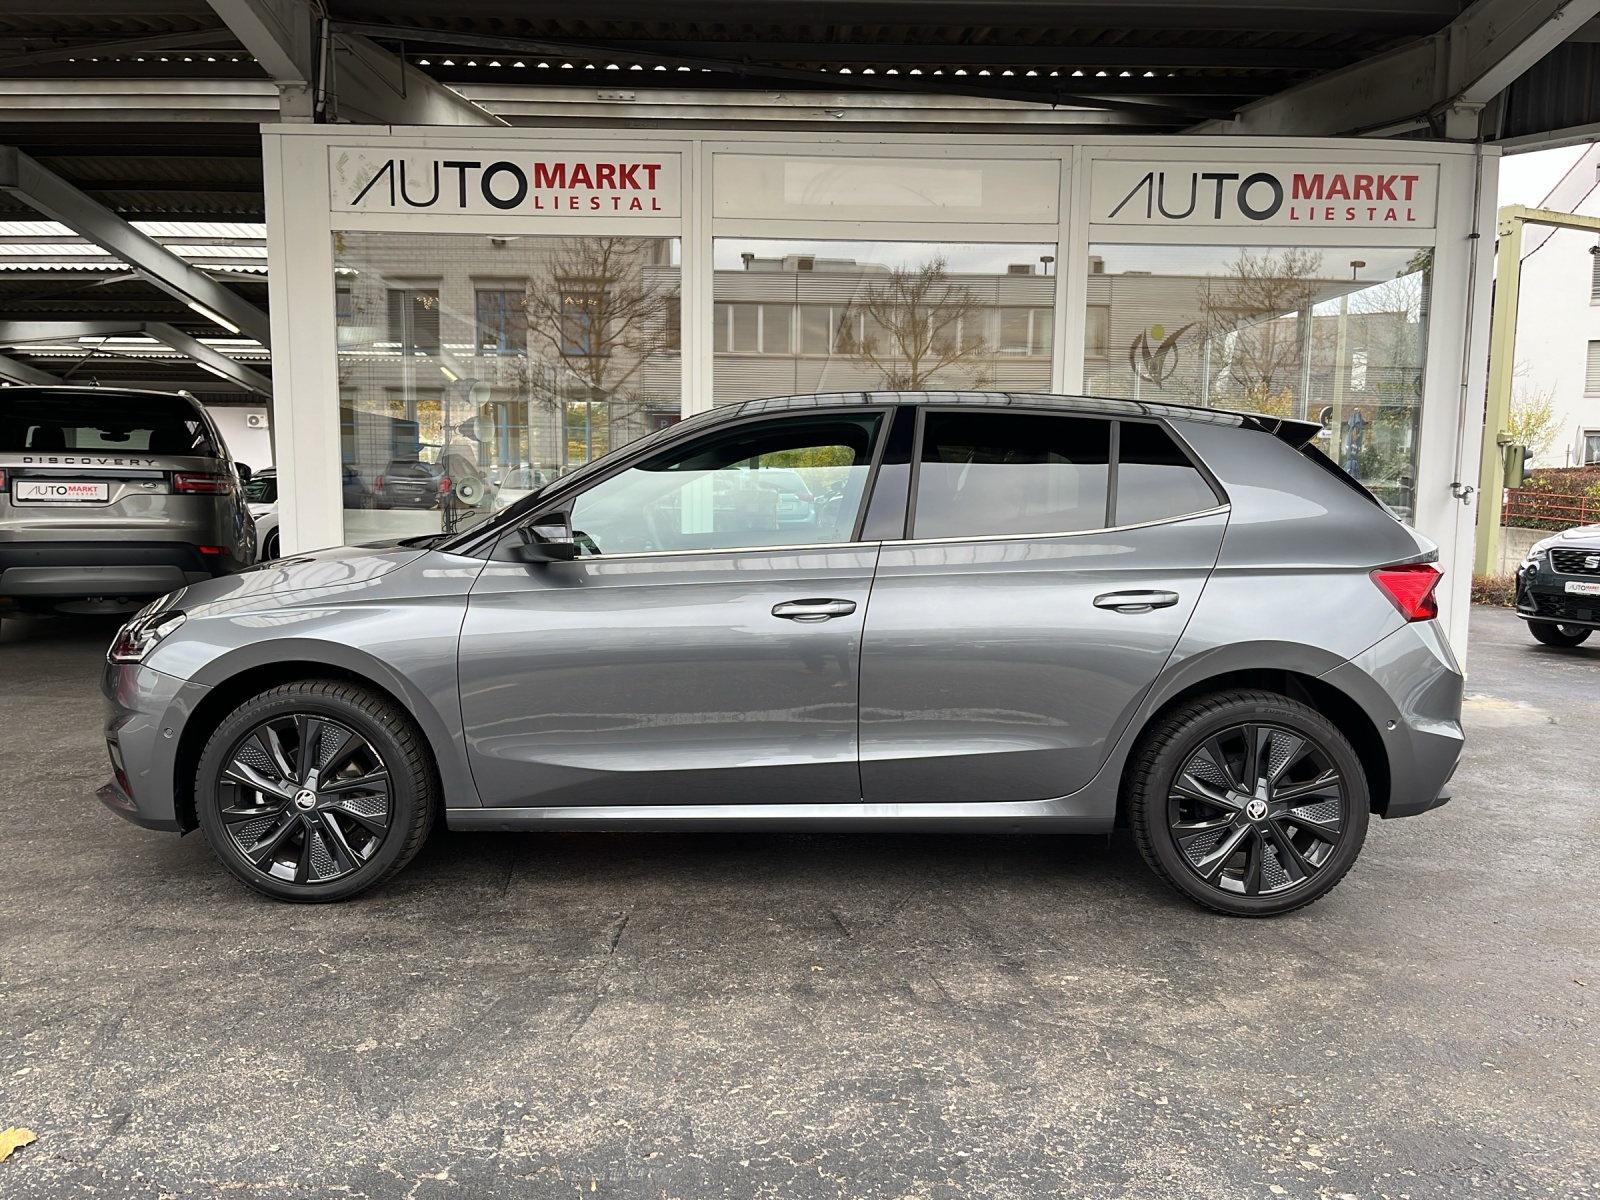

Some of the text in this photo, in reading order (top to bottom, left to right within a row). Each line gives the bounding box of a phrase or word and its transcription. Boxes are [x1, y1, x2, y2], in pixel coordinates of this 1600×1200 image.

[350, 159, 661, 210] AUTO MARKT
[534, 195, 661, 211] LIESTAL
[1107, 171, 1419, 221] AUTO MARKT
[1290, 206, 1416, 222] LIESTAL
[23, 456, 156, 467] DISCOVERY
[27, 486, 67, 495] AUTO
